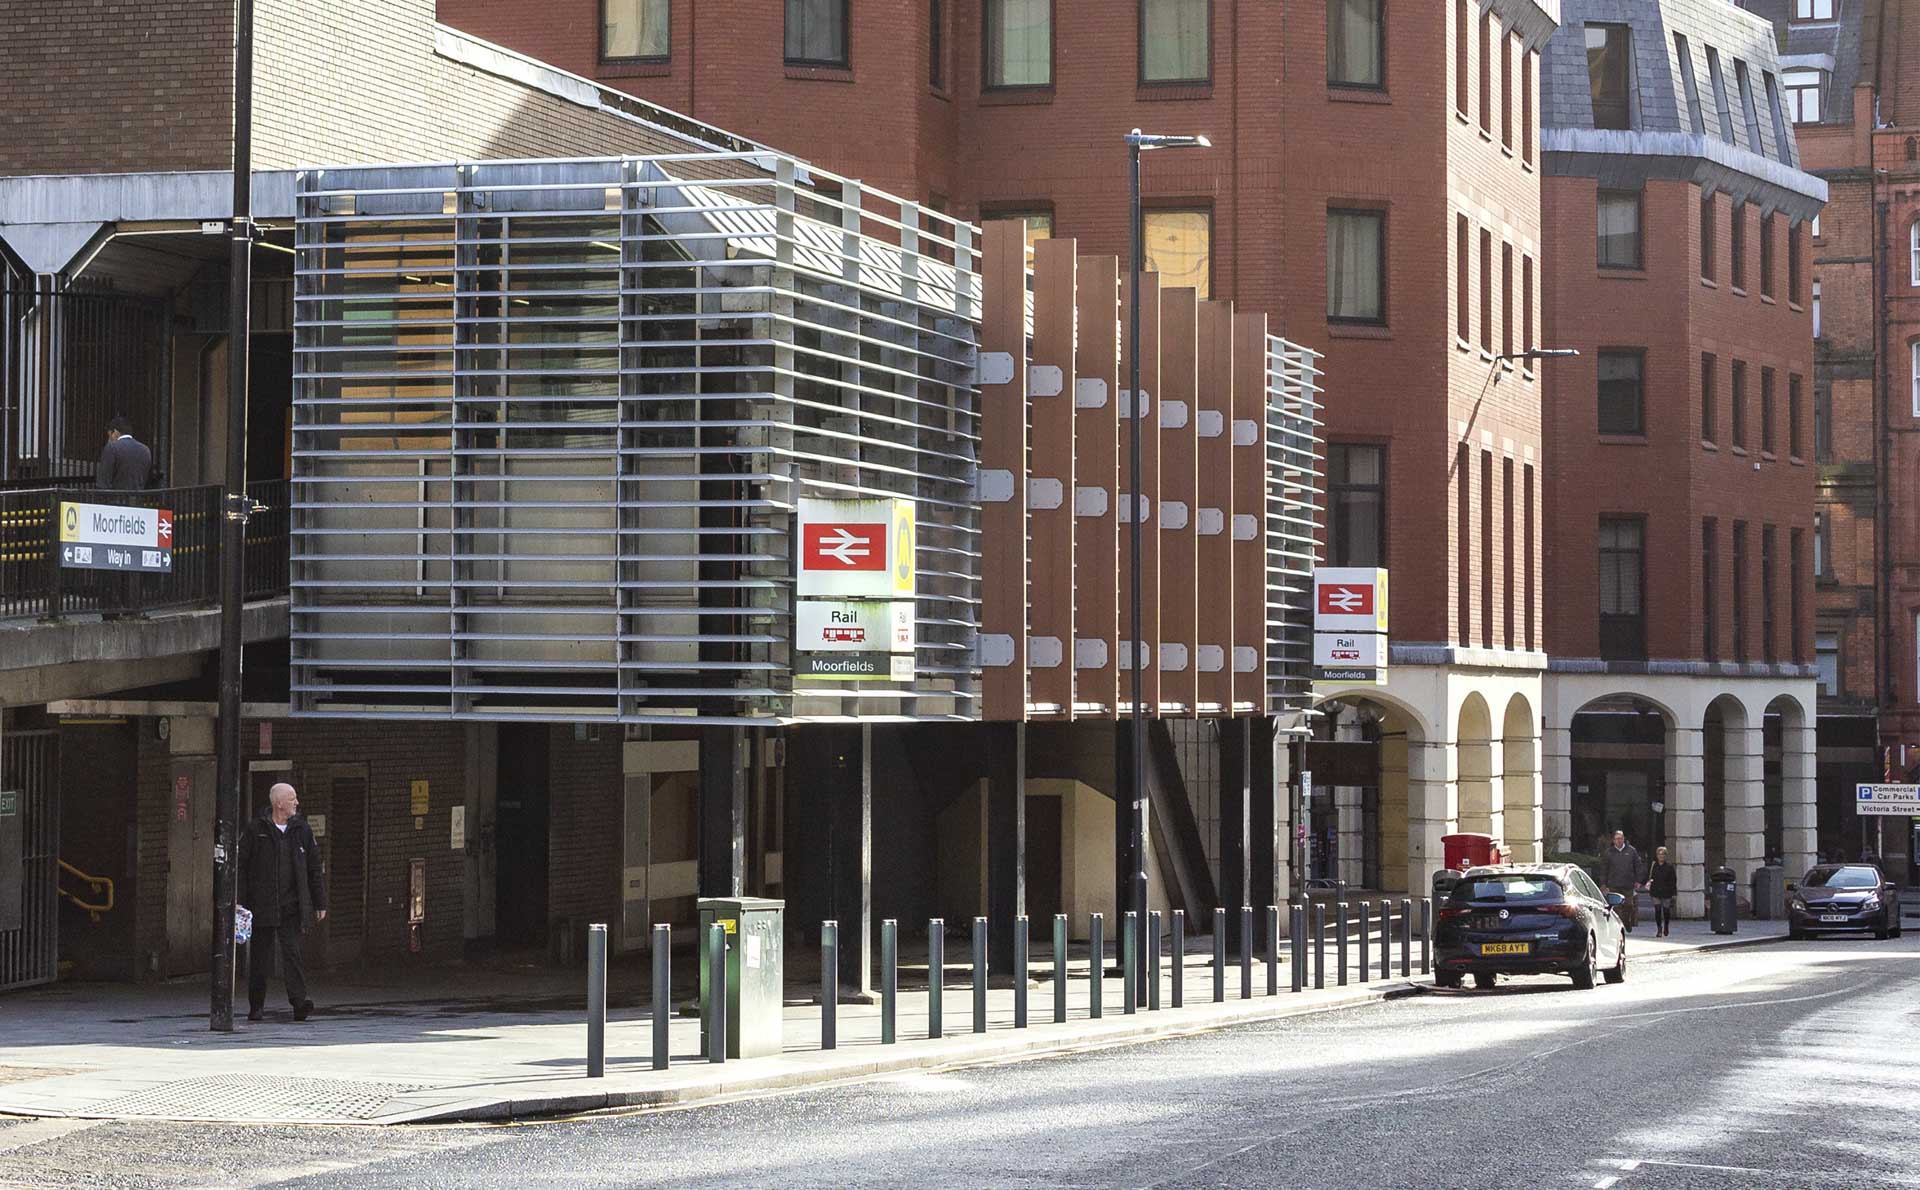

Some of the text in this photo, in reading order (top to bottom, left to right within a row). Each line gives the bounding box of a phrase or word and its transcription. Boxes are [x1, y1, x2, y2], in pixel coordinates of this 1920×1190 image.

[92, 511, 146, 536] Moorfields
[107, 548, 132, 567] Way in
[831, 610, 858, 623] Rail
[1336, 638, 1355, 648] Rail
[811, 660, 875, 673] Moorfields
[1323, 671, 1367, 680] Moorfields
[1872, 785, 1916, 793] Commercial
[1509, 943, 1527, 952] AYT
